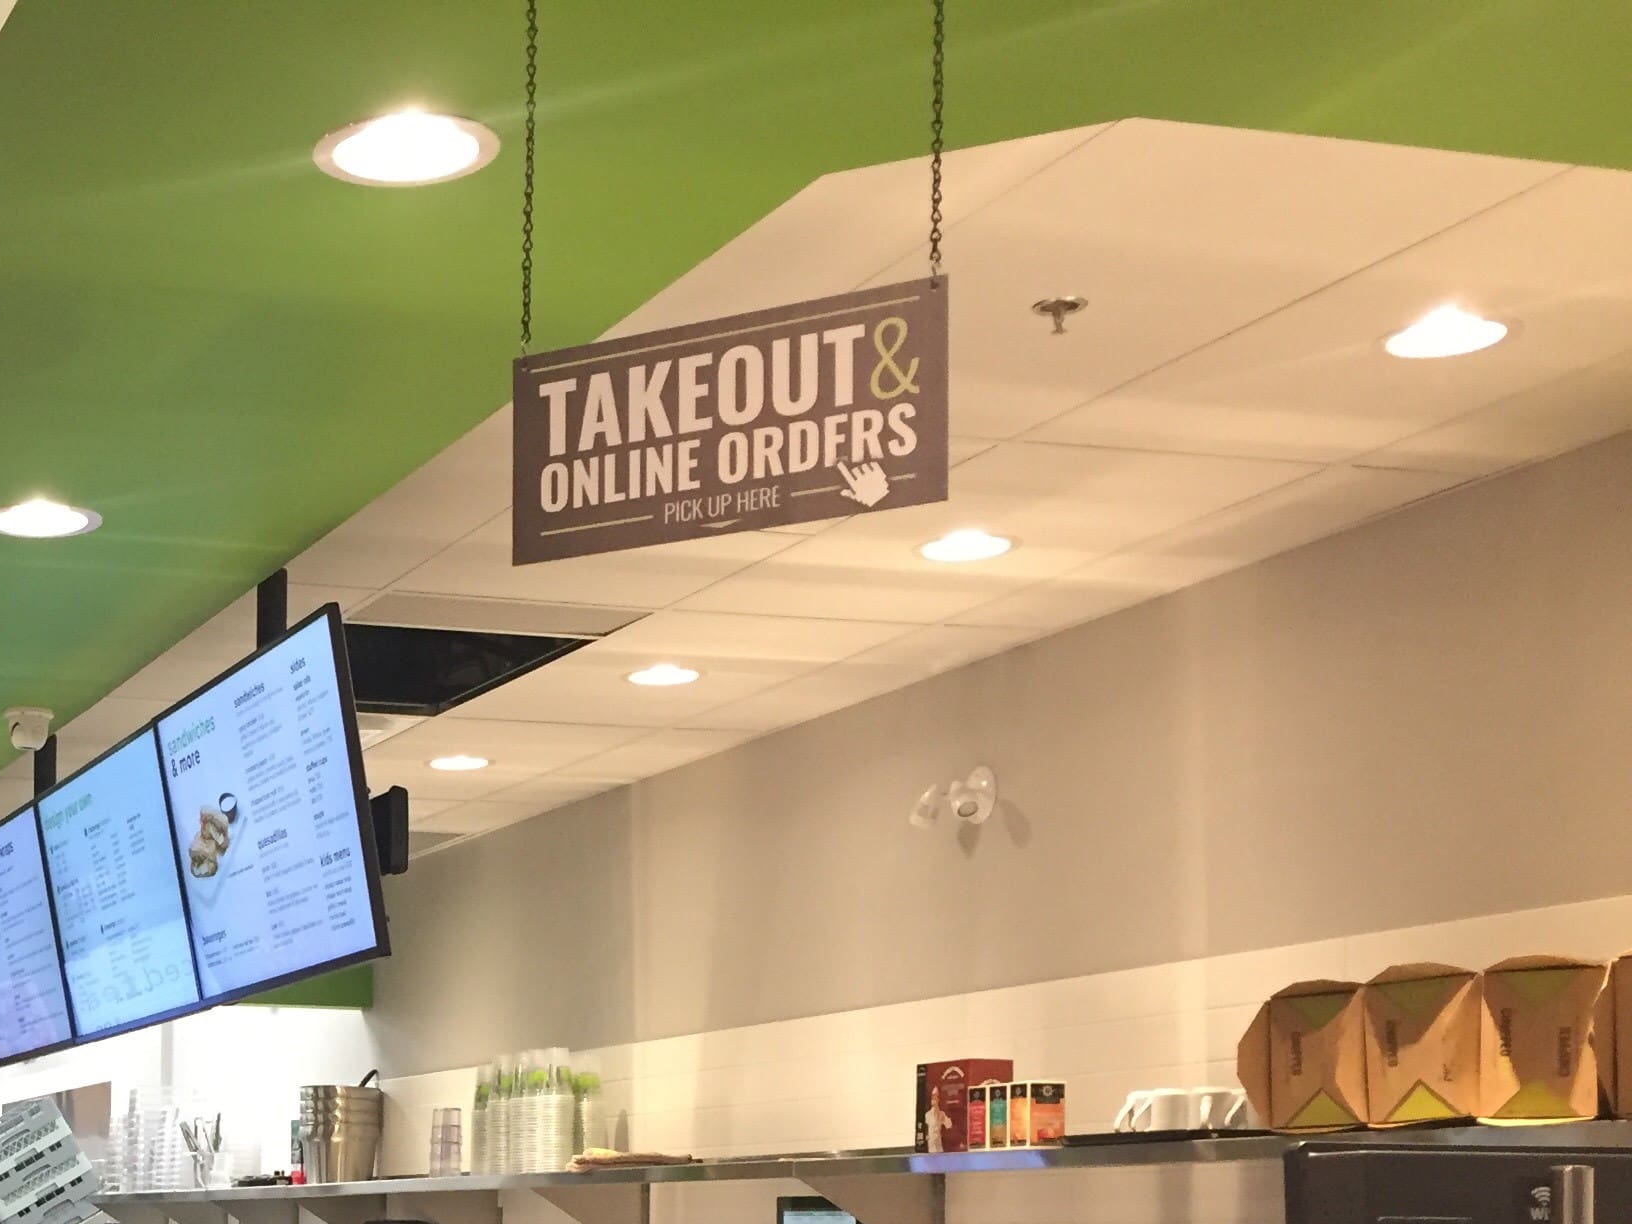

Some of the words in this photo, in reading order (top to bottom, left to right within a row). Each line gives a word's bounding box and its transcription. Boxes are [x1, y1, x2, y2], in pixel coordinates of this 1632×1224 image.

[539, 323, 865, 457] TAKEOUT
[870, 316, 920, 400] &
[540, 438, 701, 513] ONLINE
[717, 402, 918, 485] ORDERS
[664, 499, 703, 525] PICK
[708, 494, 734, 518] UP
[737, 485, 781, 513] HERE
[233, 682, 265, 708] sandwiches
[168, 715, 216, 756] sandwiches
[171, 759, 179, 778] &
[179, 750, 201, 773] more
[320, 854, 333, 867] kids
[333, 847, 351, 863] menu
